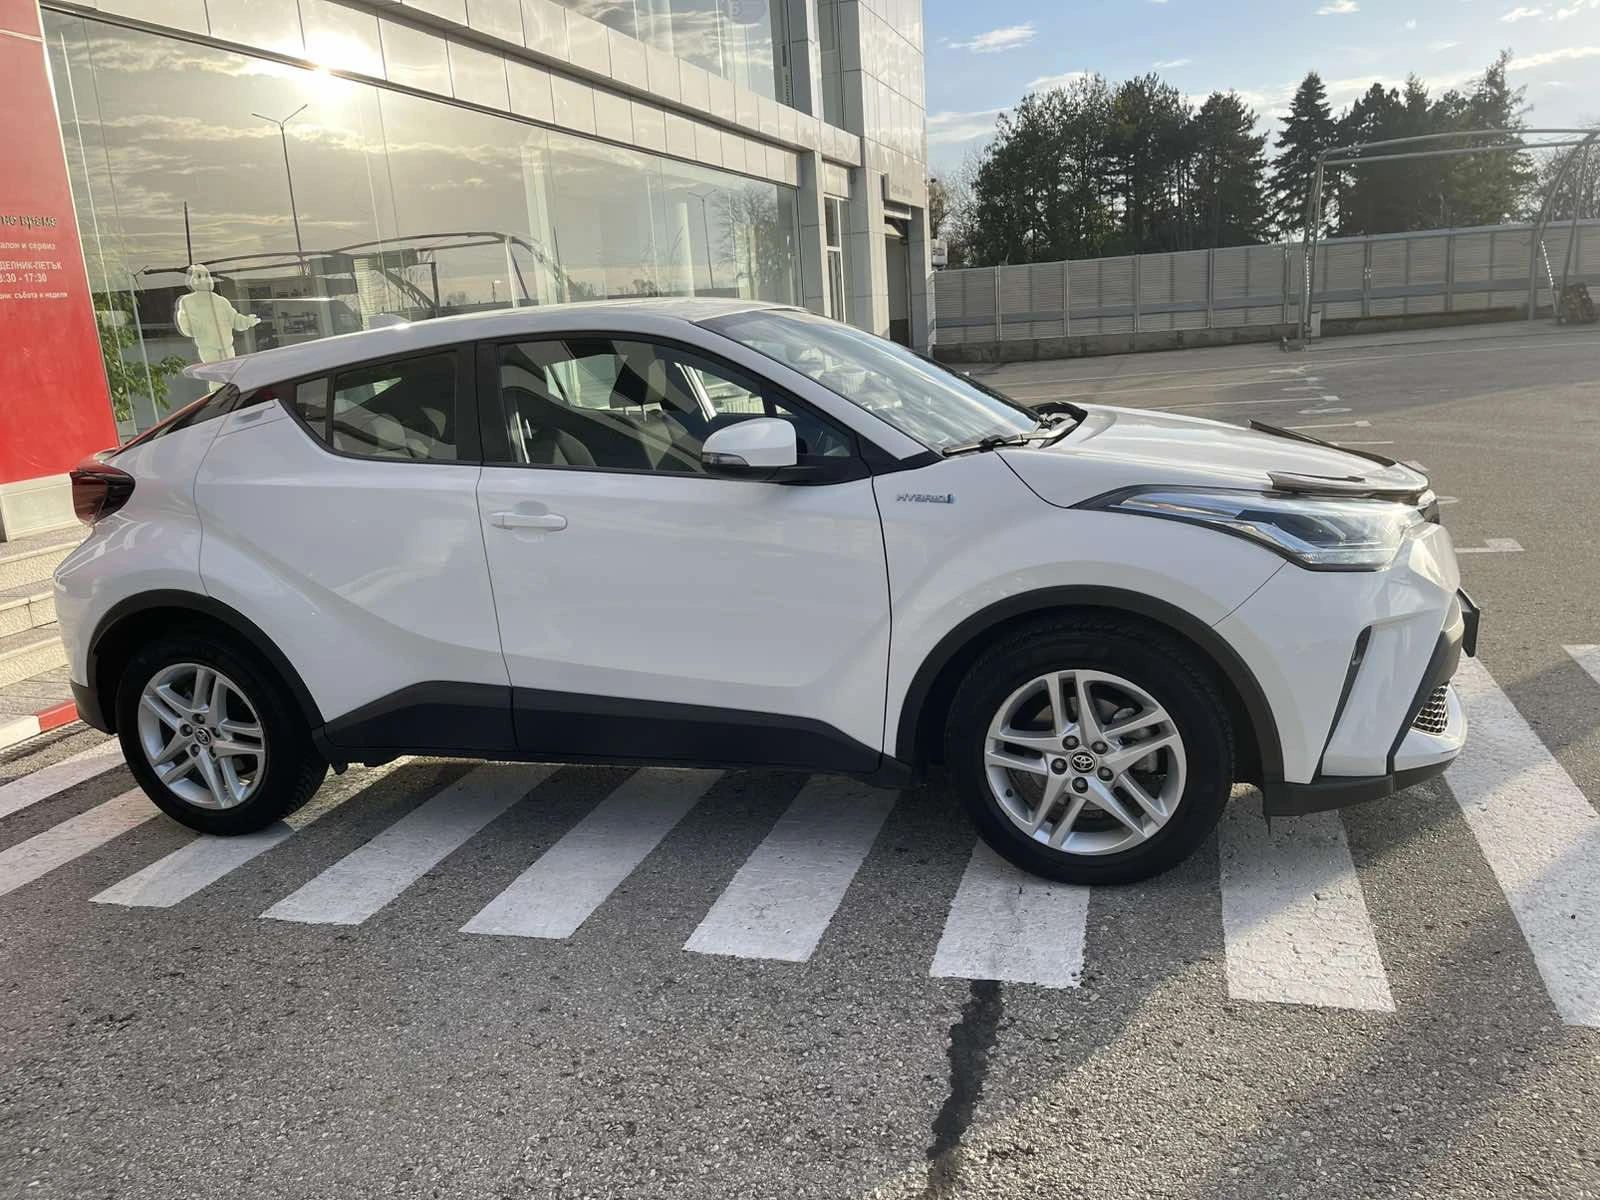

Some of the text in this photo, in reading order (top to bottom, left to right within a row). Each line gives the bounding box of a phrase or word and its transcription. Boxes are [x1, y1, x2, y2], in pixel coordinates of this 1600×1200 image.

[20, 215, 56, 230] време
[28, 243, 56, 251] сервиз
[24, 272, 47, 282] 17:30
[896, 493, 945, 504] HYBRID
